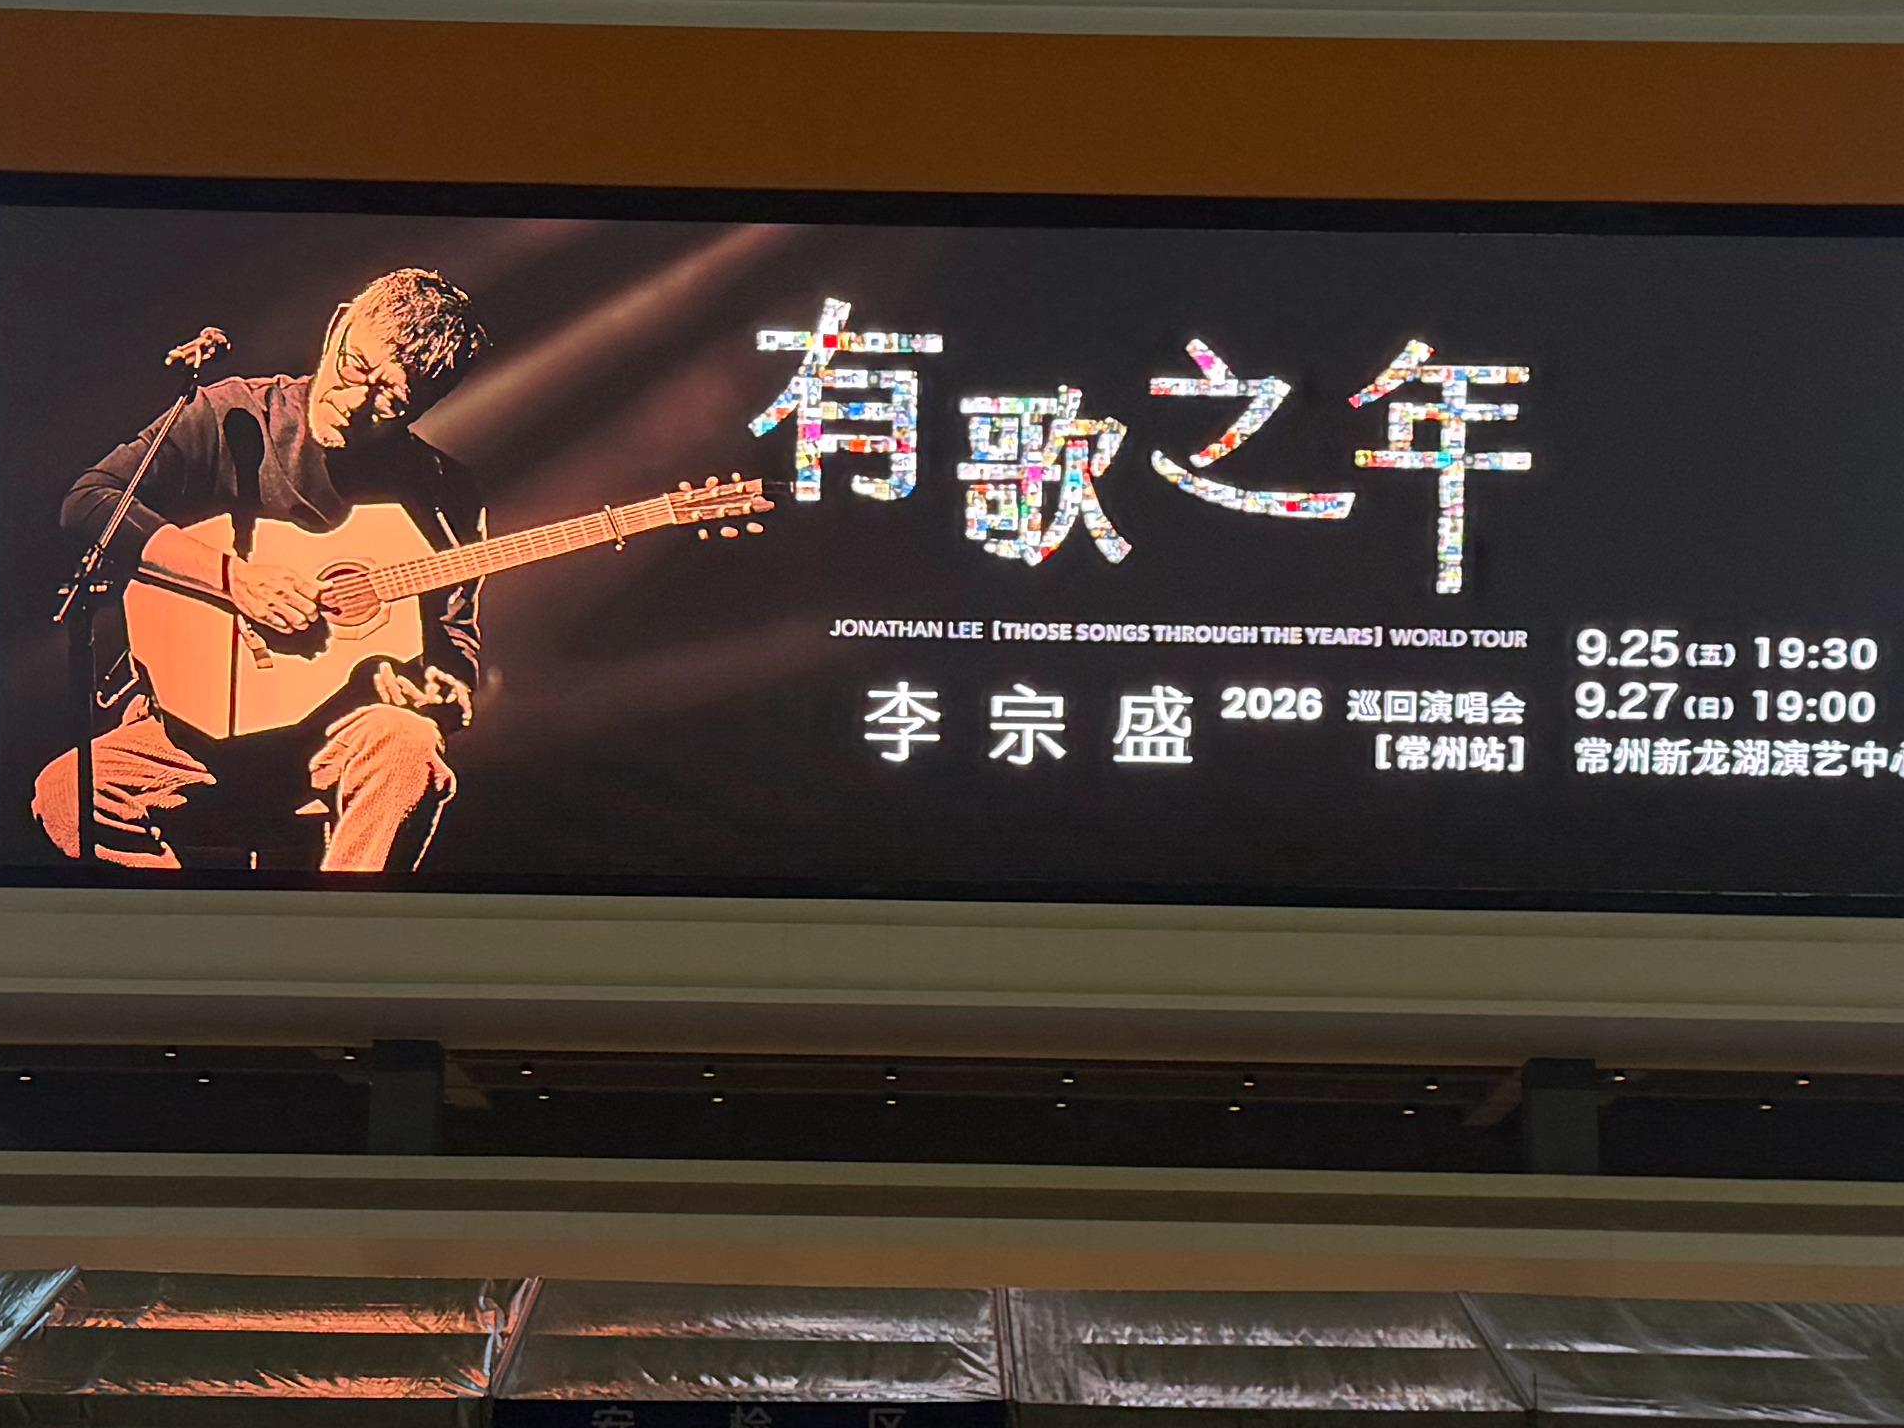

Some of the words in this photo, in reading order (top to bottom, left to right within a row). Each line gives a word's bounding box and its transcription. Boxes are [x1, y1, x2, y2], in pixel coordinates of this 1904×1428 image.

[746, 298, 1533, 595] 有歌之年
[829, 618, 944, 639] JONATHAN
[947, 621, 984, 640] LEE
[1075, 623, 1150, 643] SONGS
[1151, 624, 1259, 644] THROUGH
[1261, 625, 1304, 645] THE
[1388, 628, 1468, 648] WORLD
[1470, 629, 1529, 649] TOUR
[1753, 636, 1879, 671] 19:30
[863, 680, 1195, 766] 李宗盛
[1220, 685, 1324, 722] 2026
[1346, 688, 1527, 725] 巡回演唱会
[1751, 689, 1877, 724] 19:00
